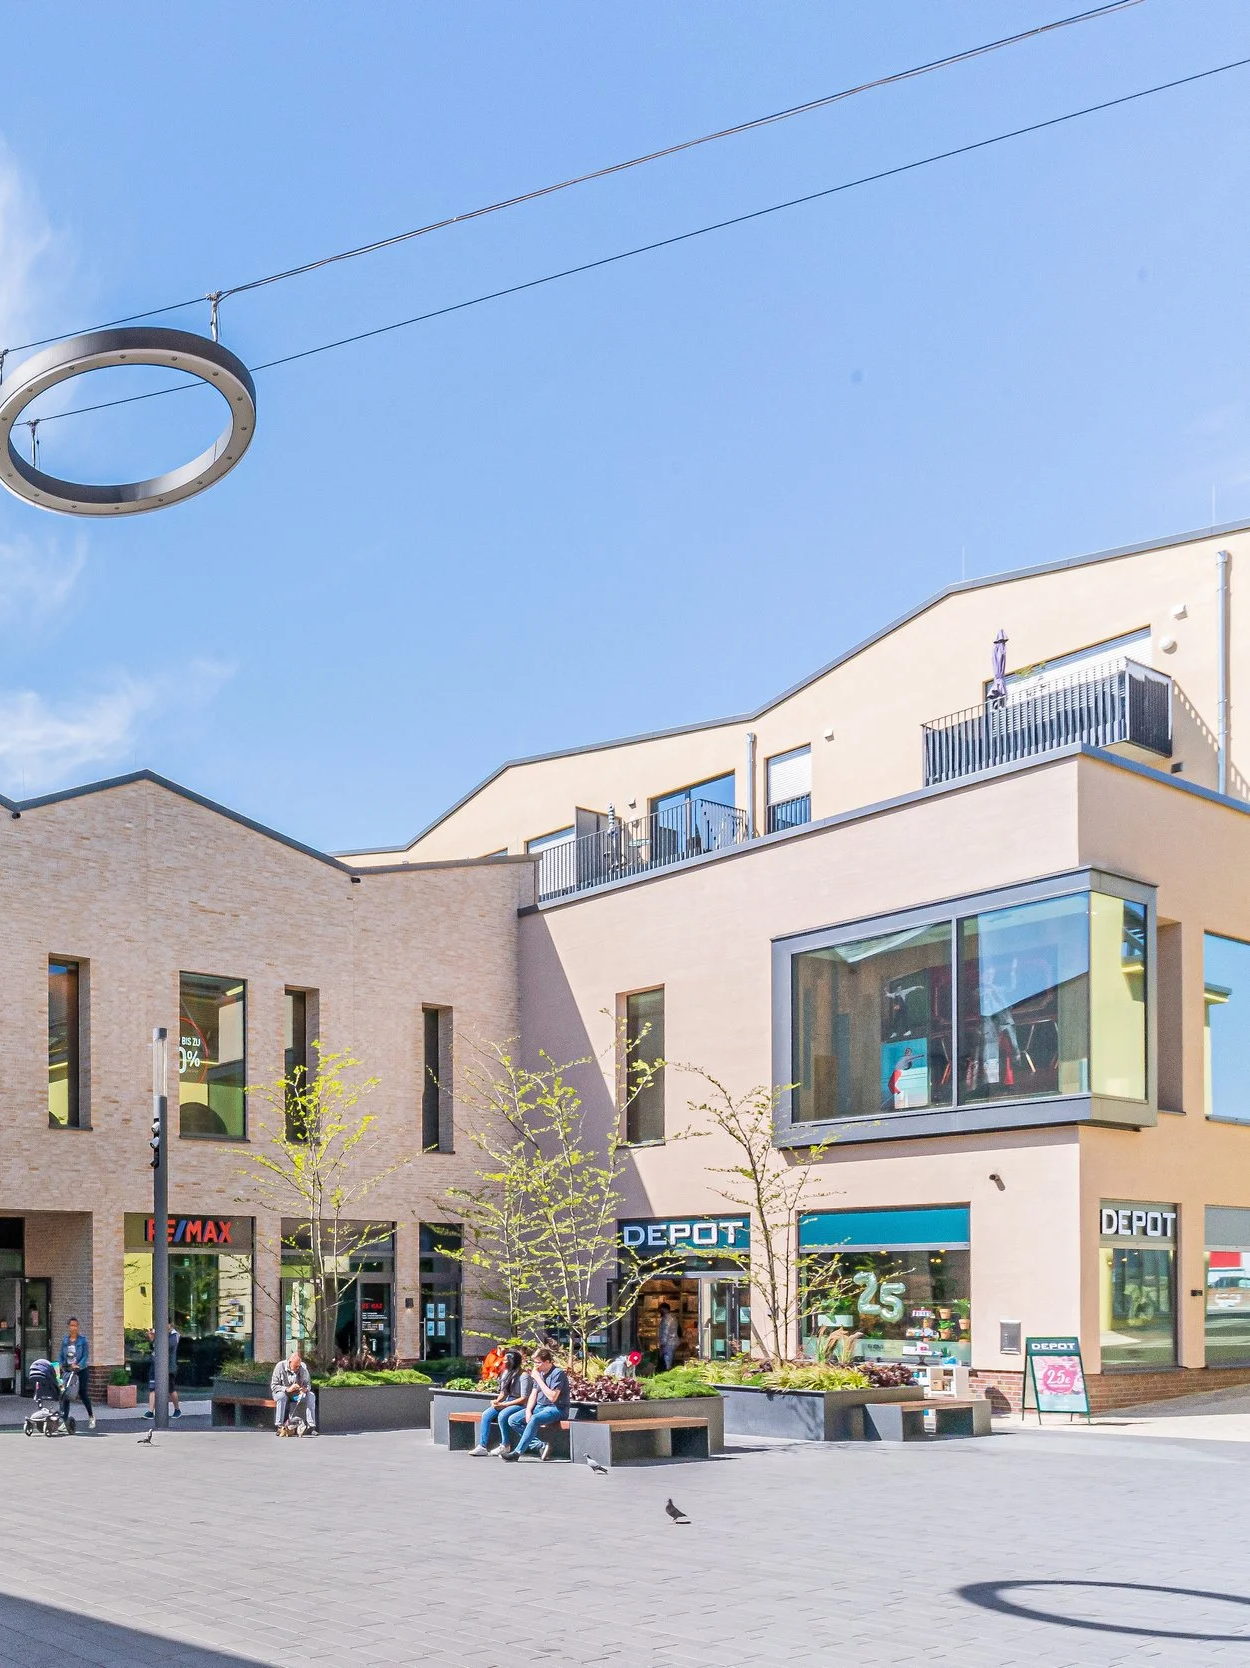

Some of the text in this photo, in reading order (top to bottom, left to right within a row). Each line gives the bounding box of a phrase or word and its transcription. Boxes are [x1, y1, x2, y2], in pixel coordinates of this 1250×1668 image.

[181, 1037, 200, 1046] BIS ZU
[623, 1221, 744, 1246] DEPOT
[1101, 1208, 1176, 1237] DEPOT
[853, 1271, 906, 1323] 25
[1031, 1343, 1076, 1351] DEPOT
